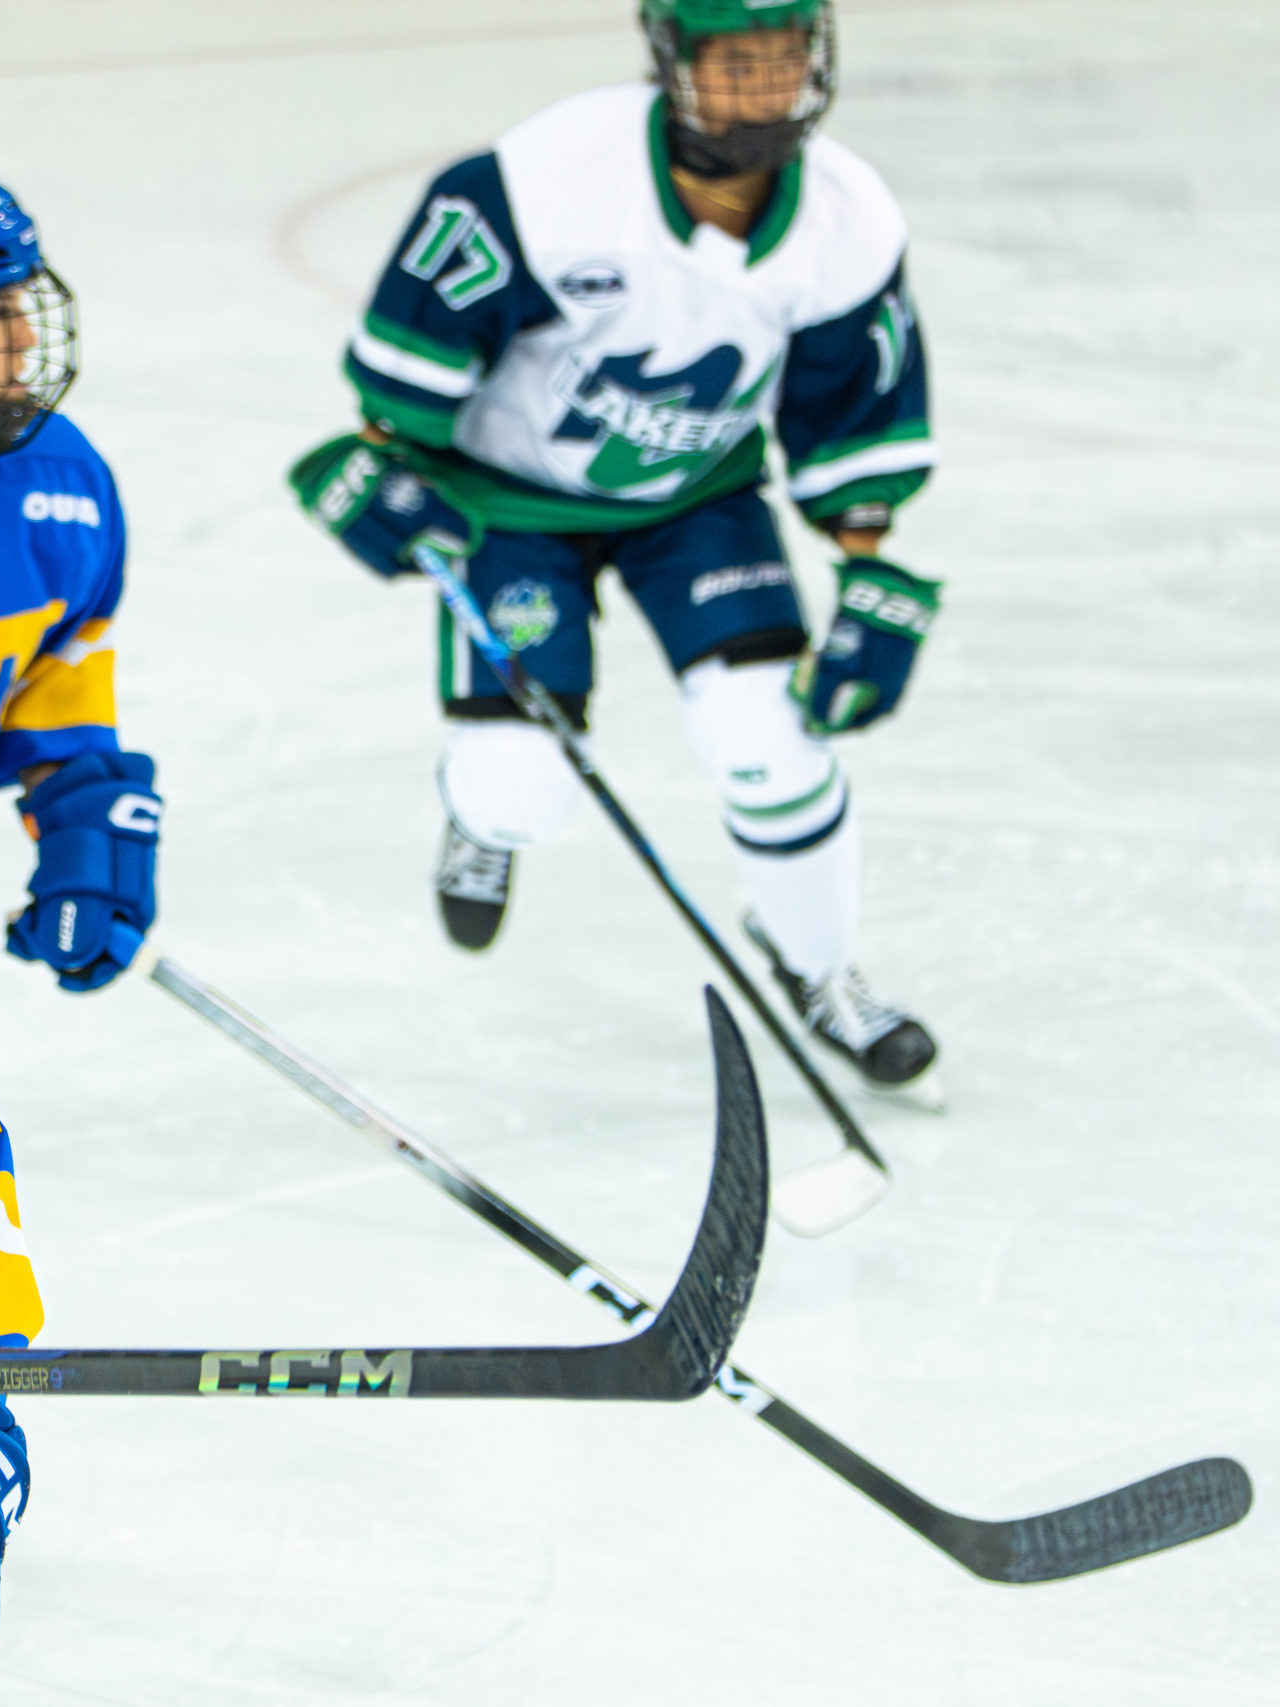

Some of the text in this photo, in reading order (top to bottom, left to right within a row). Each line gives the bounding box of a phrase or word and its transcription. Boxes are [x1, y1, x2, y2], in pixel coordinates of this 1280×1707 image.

[401, 197, 513, 311] 17
[22, 491, 100, 528] OUA
[198, 1350, 414, 1397] CCM
